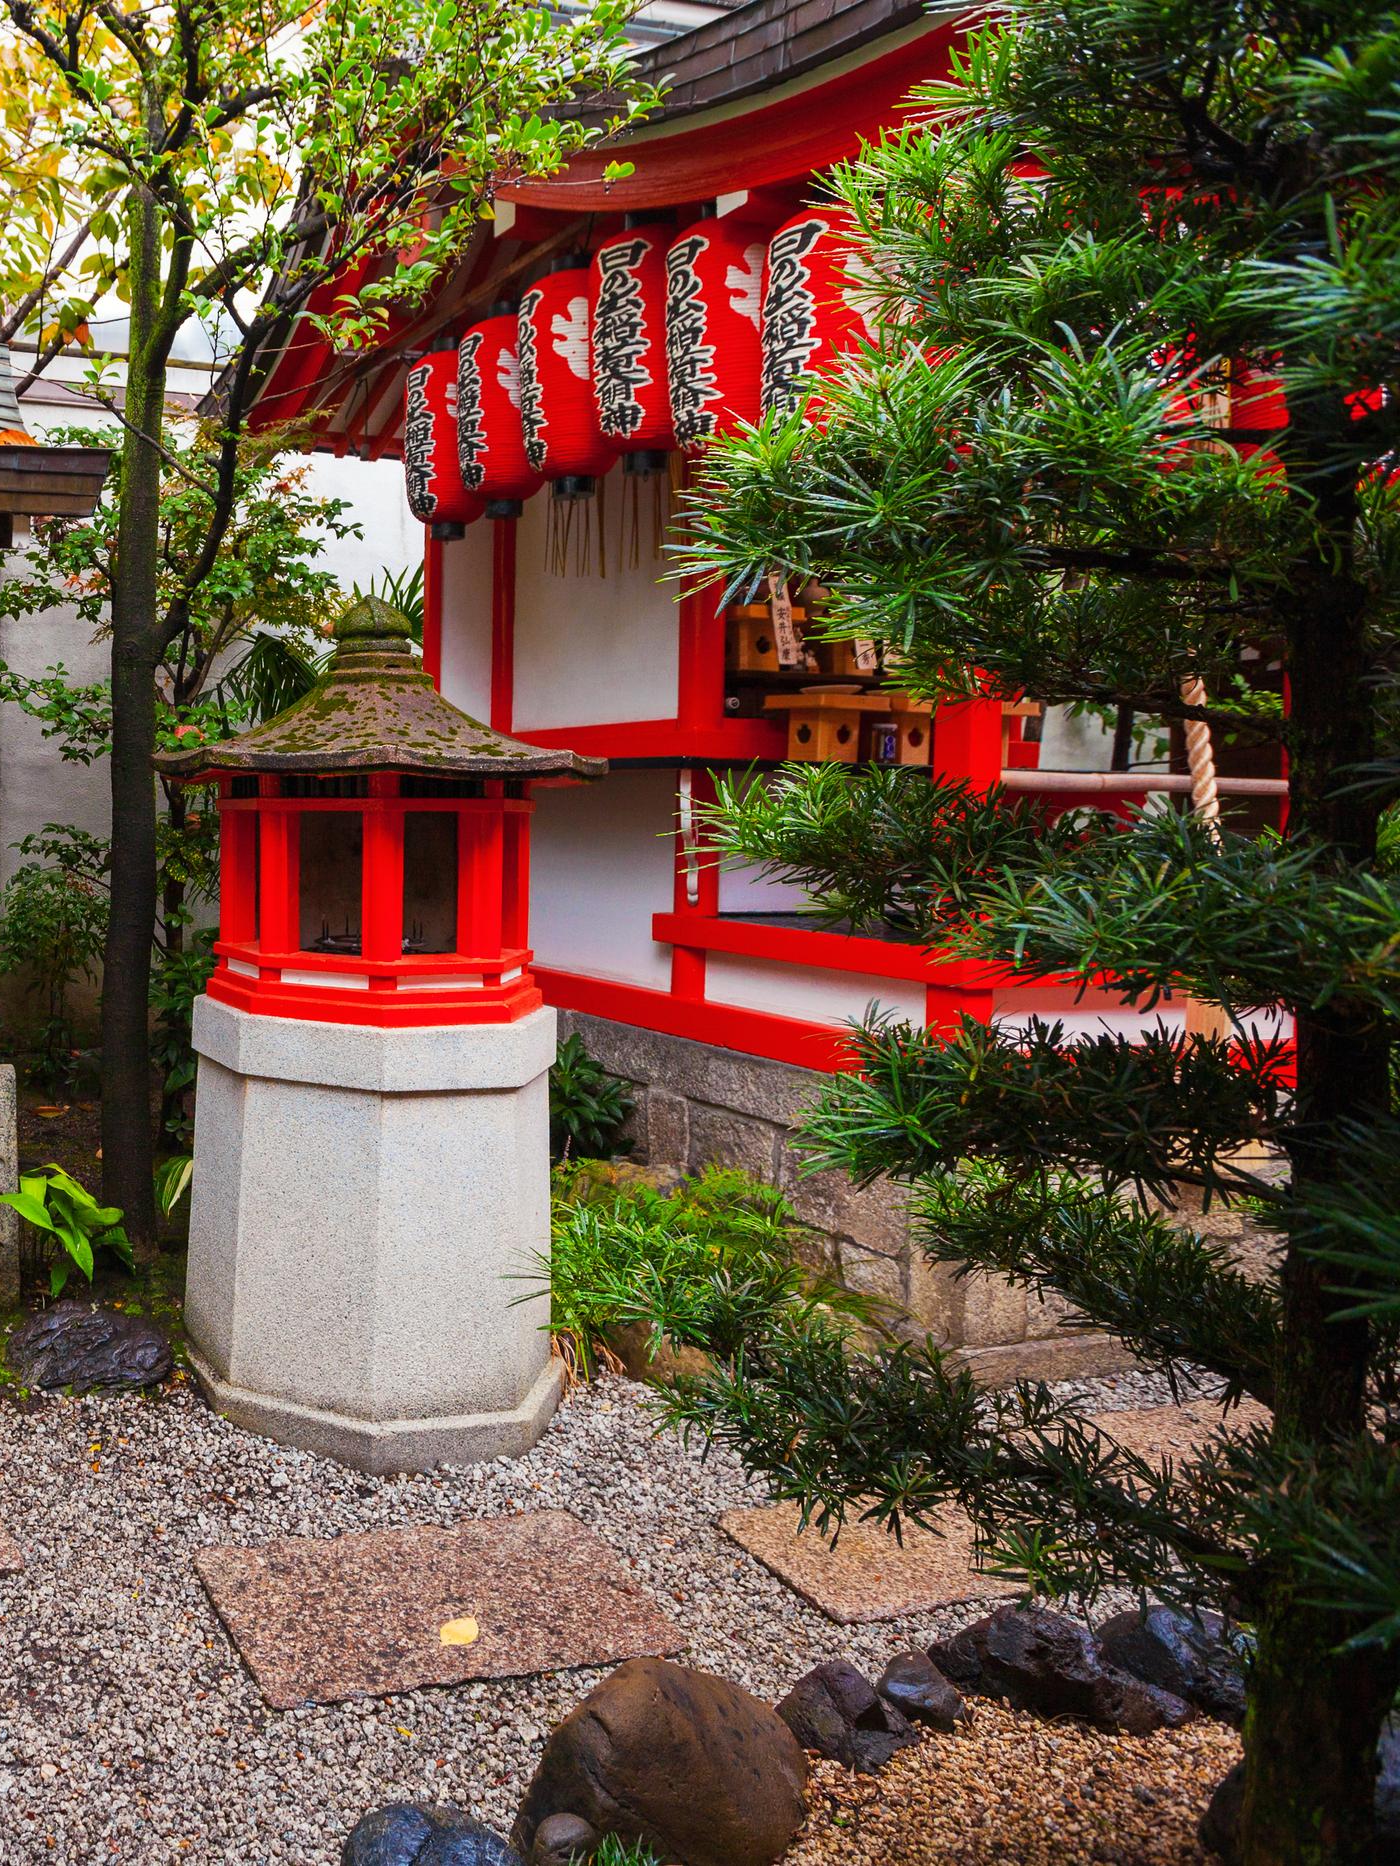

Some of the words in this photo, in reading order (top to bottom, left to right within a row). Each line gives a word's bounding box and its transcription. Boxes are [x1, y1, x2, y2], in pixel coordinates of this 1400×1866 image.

[593, 239, 653, 438] 日の出稲荷大明神
[760, 219, 829, 444] 日の出稲荷大明
